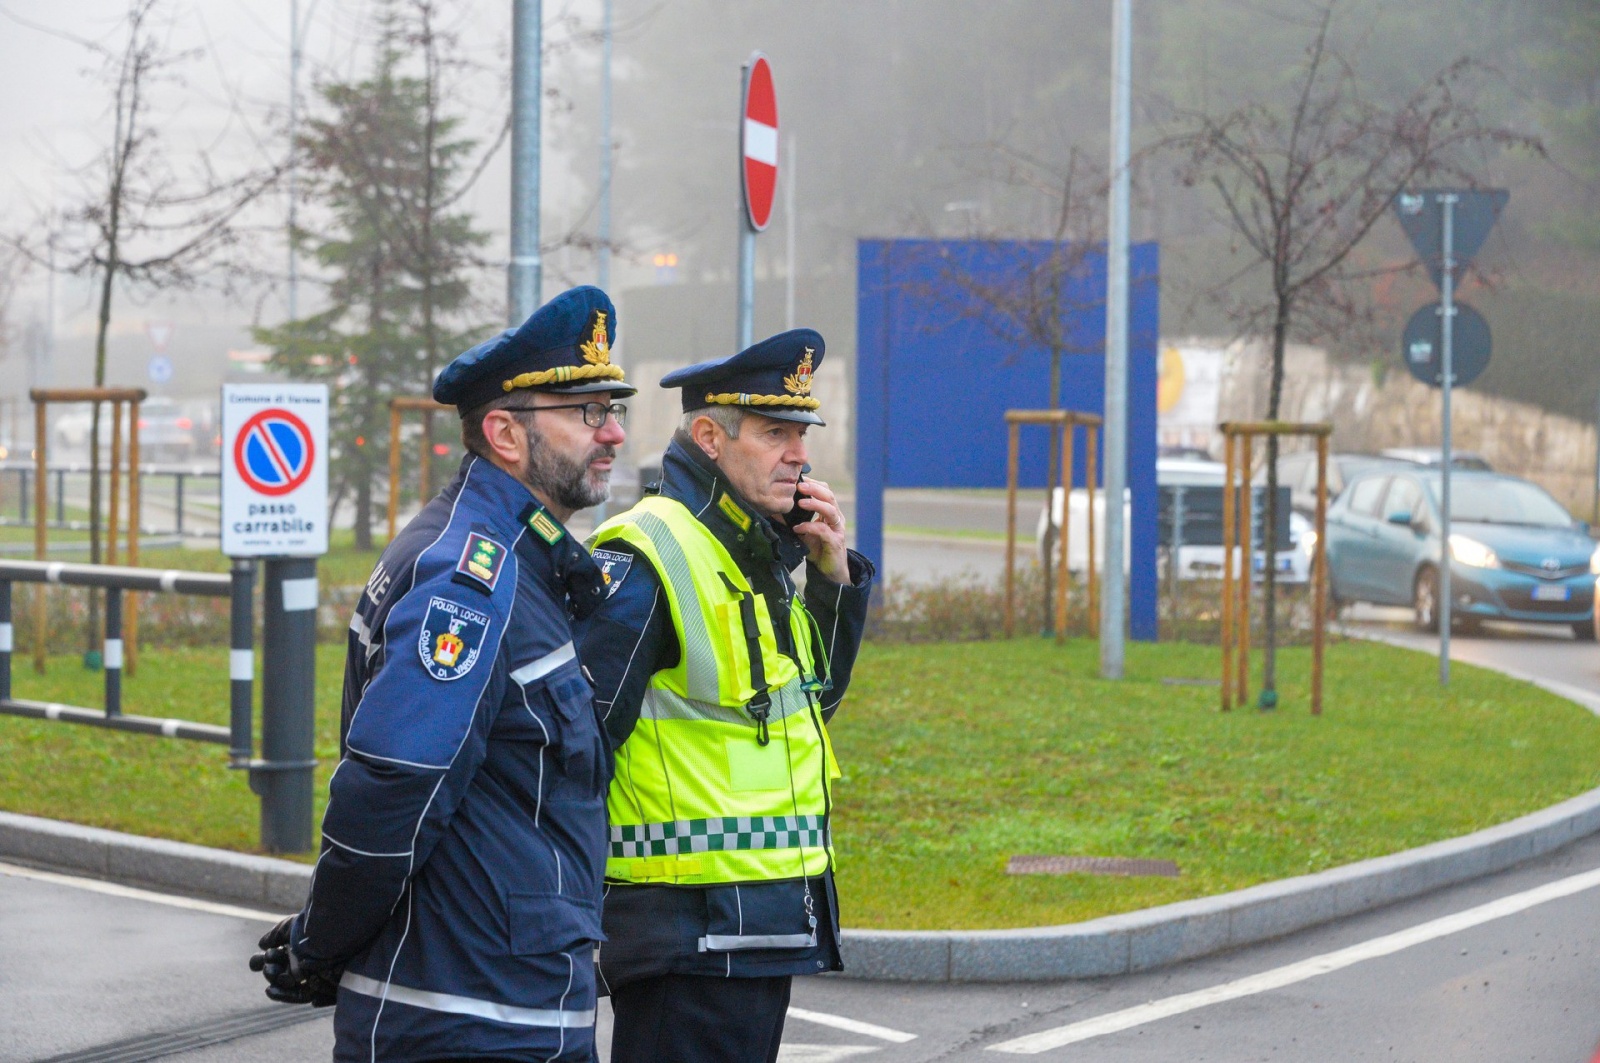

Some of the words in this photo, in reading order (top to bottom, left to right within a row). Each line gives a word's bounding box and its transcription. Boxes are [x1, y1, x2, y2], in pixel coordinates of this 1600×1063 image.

[248, 503, 296, 515] passo
[233, 520, 314, 533] carrabile
[593, 551, 611, 560] POLIZIA
[432, 600, 458, 615] POLIZIA
[461, 609, 487, 626] LOCALE
[421, 630, 435, 668] COMUNE
[437, 668, 447, 678] DI
[454, 648, 477, 675] VARESE
